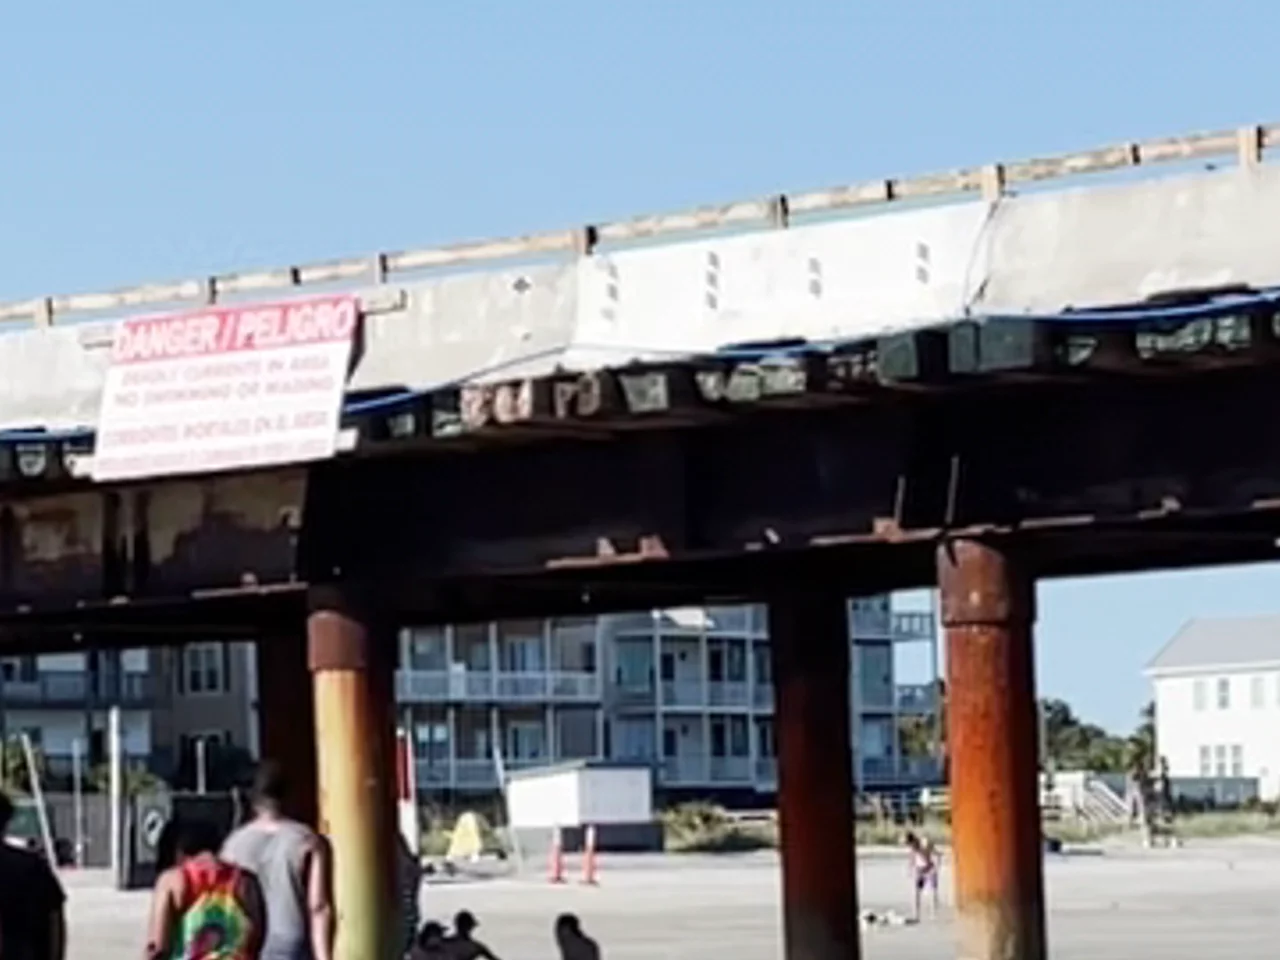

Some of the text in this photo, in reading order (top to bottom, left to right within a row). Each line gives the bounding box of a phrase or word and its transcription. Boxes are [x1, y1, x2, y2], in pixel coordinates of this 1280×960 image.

[113, 317, 220, 358] DANGER
[236, 301, 353, 346] PELIGRO
[114, 389, 139, 407] NO
